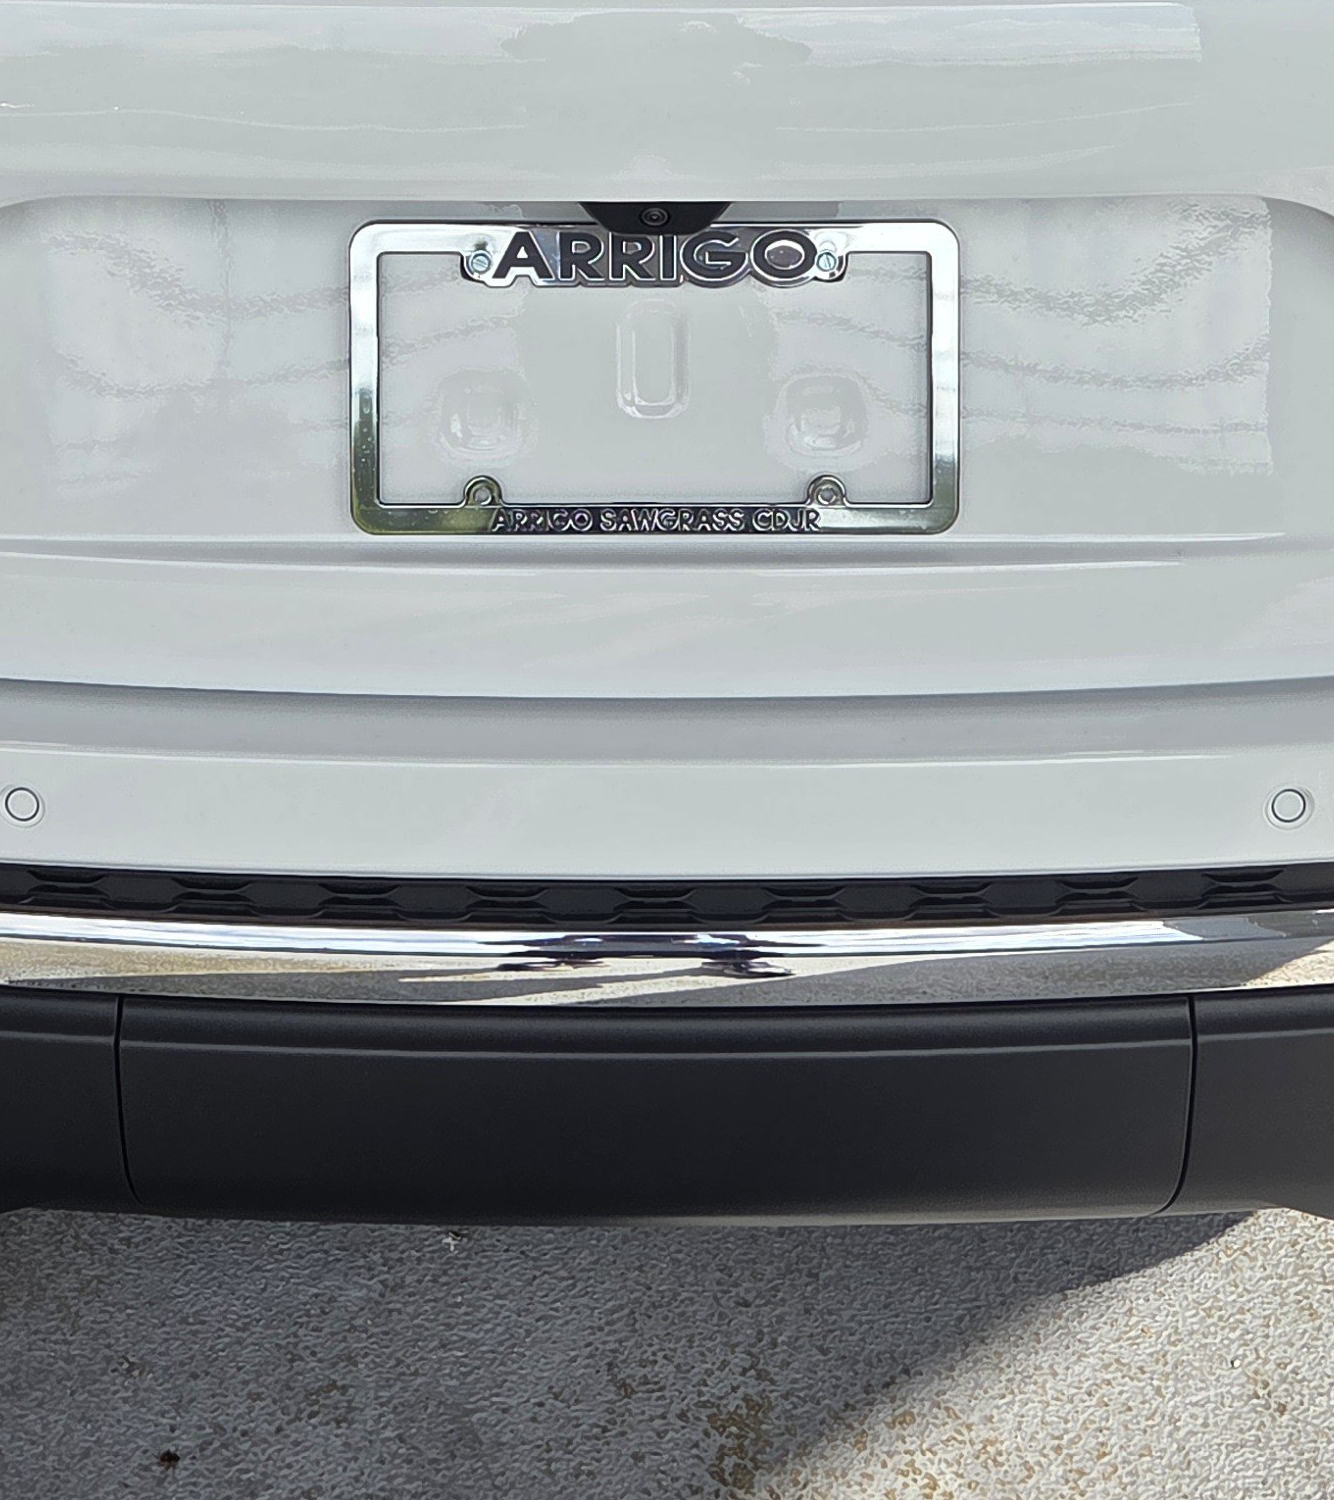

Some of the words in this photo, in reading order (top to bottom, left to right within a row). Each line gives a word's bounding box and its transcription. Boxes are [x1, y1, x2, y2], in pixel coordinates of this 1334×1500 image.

[489, 230, 818, 285] ARRIGO
[490, 508, 593, 532] ARRIGO
[599, 508, 745, 532] SAWGRASS
[752, 508, 821, 532] CDJR
